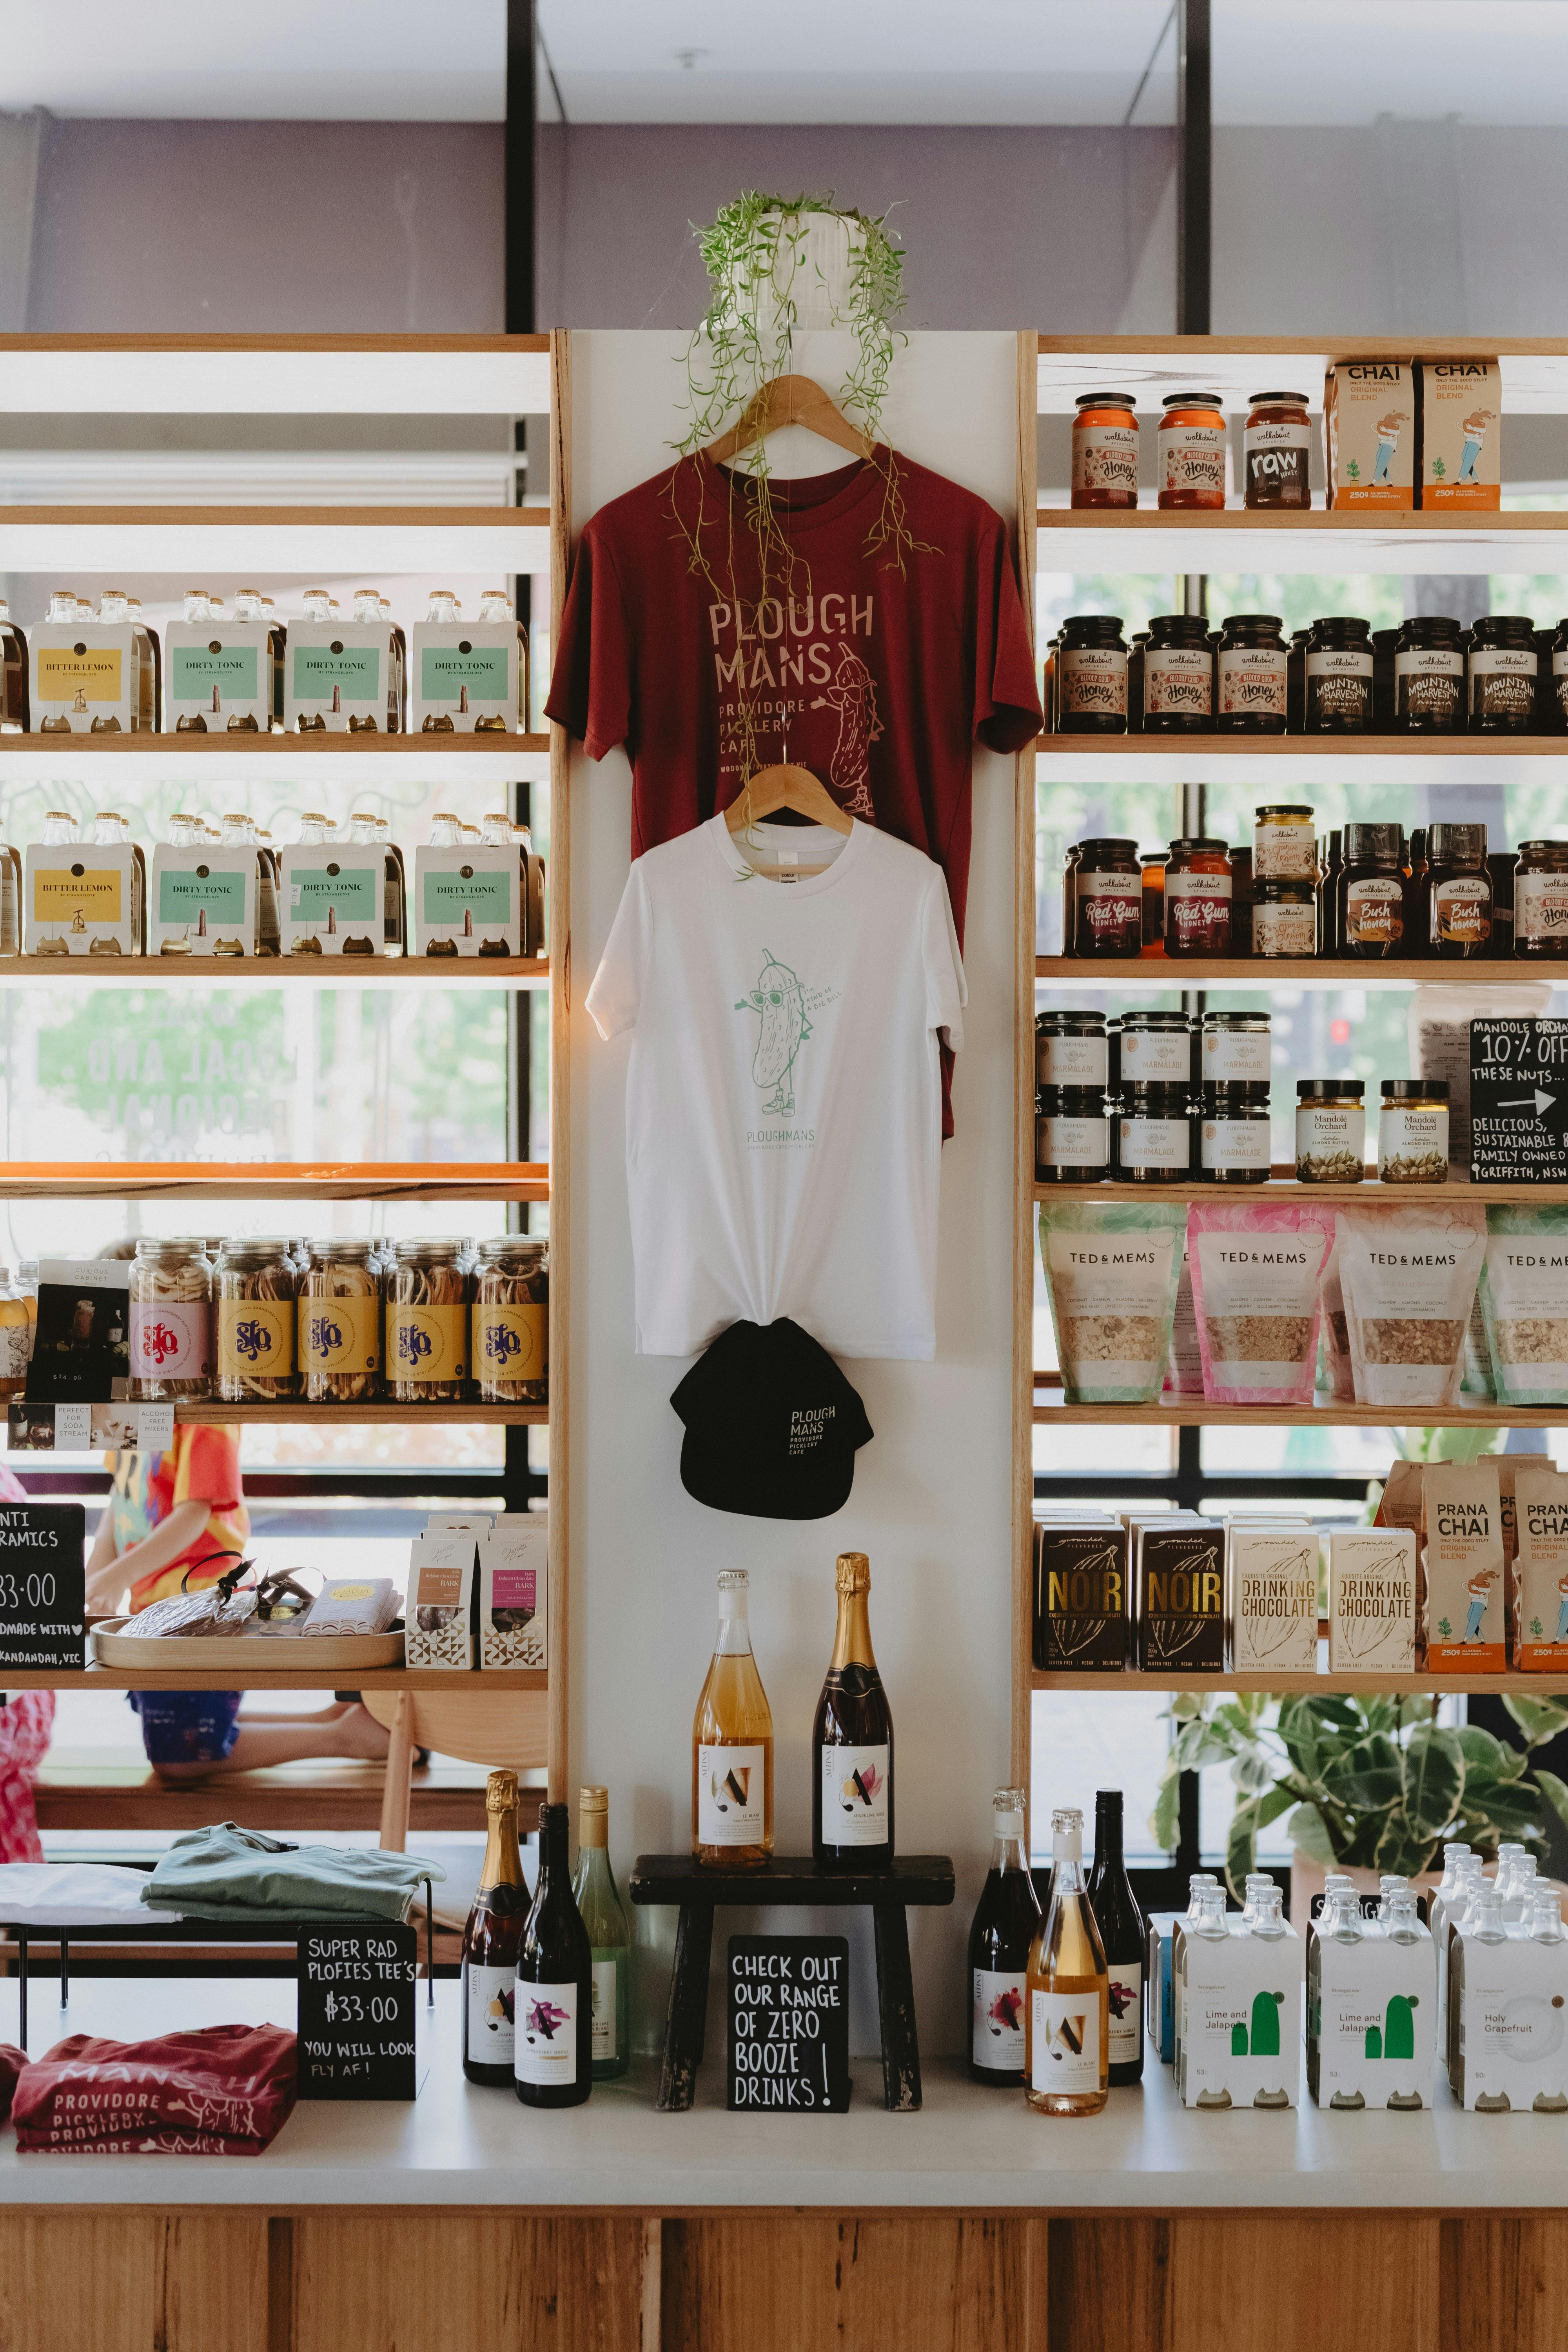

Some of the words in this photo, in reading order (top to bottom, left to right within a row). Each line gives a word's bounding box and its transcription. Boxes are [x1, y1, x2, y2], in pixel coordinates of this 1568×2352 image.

[1348, 365, 1401, 381] CHAI
[1185, 432, 1218, 443] walkabout
[1257, 430, 1291, 442] walkabout
[1205, 452, 1216, 461] GOOD
[1251, 450, 1298, 478] raw
[1181, 461, 1219, 480] Honey
[1280, 470, 1298, 479] HONEY
[709, 593, 873, 645] PLOUGH
[1241, 654, 1275, 664] walkabout
[715, 642, 831, 693] MANS
[1243, 674, 1261, 683] BLOODY
[1261, 675, 1273, 684] GOOD
[1238, 683, 1276, 703] Honey
[1316, 677, 1368, 699] MOUNTAIN
[1325, 687, 1359, 700] HARVEST
[719, 699, 805, 719] PROVIDORE
[720, 739, 755, 754] CAFE
[1272, 844, 1298, 856] Orange
[1269, 852, 1301, 864] Blossom
[172, 886, 203, 894] DIRTY
[1099, 878, 1132, 889] walkabout
[1085, 900, 1112, 921] Red
[1113, 902, 1140, 924] Gum
[1361, 902, 1390, 918] Bush
[1095, 918, 1117, 927] HONEY
[1360, 916, 1391, 931] honey
[804, 987, 815, 995] I'M
[806, 990, 822, 1004] KIND
[823, 986, 833, 995] OF
[814, 1000, 826, 1009] BIG
[827, 991, 843, 1005] DILL
[1474, 1021, 1530, 1034] MANDOLE
[1481, 1033, 1531, 1063] 10%
[1143, 1060, 1183, 1069] MARMALADE
[1471, 1067, 1513, 1081] THESE
[1517, 1069, 1565, 1086] NUTS...
[1314, 1114, 1347, 1123] Mandolé
[1473, 1118, 1547, 1133] DELICIOUS,
[1314, 1122, 1347, 1131] Orchard
[746, 1129, 815, 1143] PLOUGHMANS
[1474, 1132, 1555, 1148] SUSTAINABLE
[1473, 1150, 1518, 1162] FAMILY
[1522, 1151, 1566, 1161] OWNED
[1481, 1167, 1539, 1180] GRIFFITH,
[1543, 1167, 1567, 1178] NSW
[1070, 1252, 1098, 1264] TED
[1101, 1254, 1109, 1264] &
[1112, 1252, 1156, 1263] MEMS
[1220, 1252, 1249, 1263] TED
[1251, 1253, 1259, 1263] &
[1263, 1252, 1307, 1263] MEMS
[791, 1405, 836, 1423] PLOUGH
[790, 1421, 824, 1436] MANS
[790, 1434, 823, 1443] PROVIDORE
[1437, 1504, 1488, 1516] PRANA
[1438, 1517, 1489, 1536] CHAI
[1149, 1572, 1221, 1613] NOIR
[1242, 1580, 1315, 1598] DRINKING
[1241, 1598, 1315, 1618] CHOCOLATE
[40, 1623, 71, 1636] WITH
[63, 1653, 81, 1664] VIC
[308, 1938, 361, 1959] SUPER
[366, 1939, 397, 1958] RAD
[308, 1962, 372, 1981] PLOFIES
[374, 1960, 416, 1982] TEE'S
[732, 1955, 792, 1978] CHECK
[801, 1956, 842, 1981] OUT
[734, 1983, 774, 2005] OUR
[780, 1984, 841, 2008] RANGE
[324, 1990, 398, 2024] $33.00
[1205, 2010, 1228, 2019] Lime
[1230, 2010, 1247, 2018] and
[735, 2011, 757, 2038] OF
[767, 2010, 820, 2040] ZERO
[1205, 2020, 1247, 2031] Jalapeño
[1484, 2013, 1506, 2024] Holy
[1484, 2024, 1533, 2034] Grapefruit
[304, 2041, 332, 2057] YOU
[337, 2042, 376, 2058] WILL
[379, 2042, 416, 2056] LOOK
[735, 2042, 799, 2074] BOOZE
[310, 2064, 334, 2078] FLY
[735, 2076, 815, 2107] DRINKS
[54, 2093, 160, 2110] PROVIDORE
